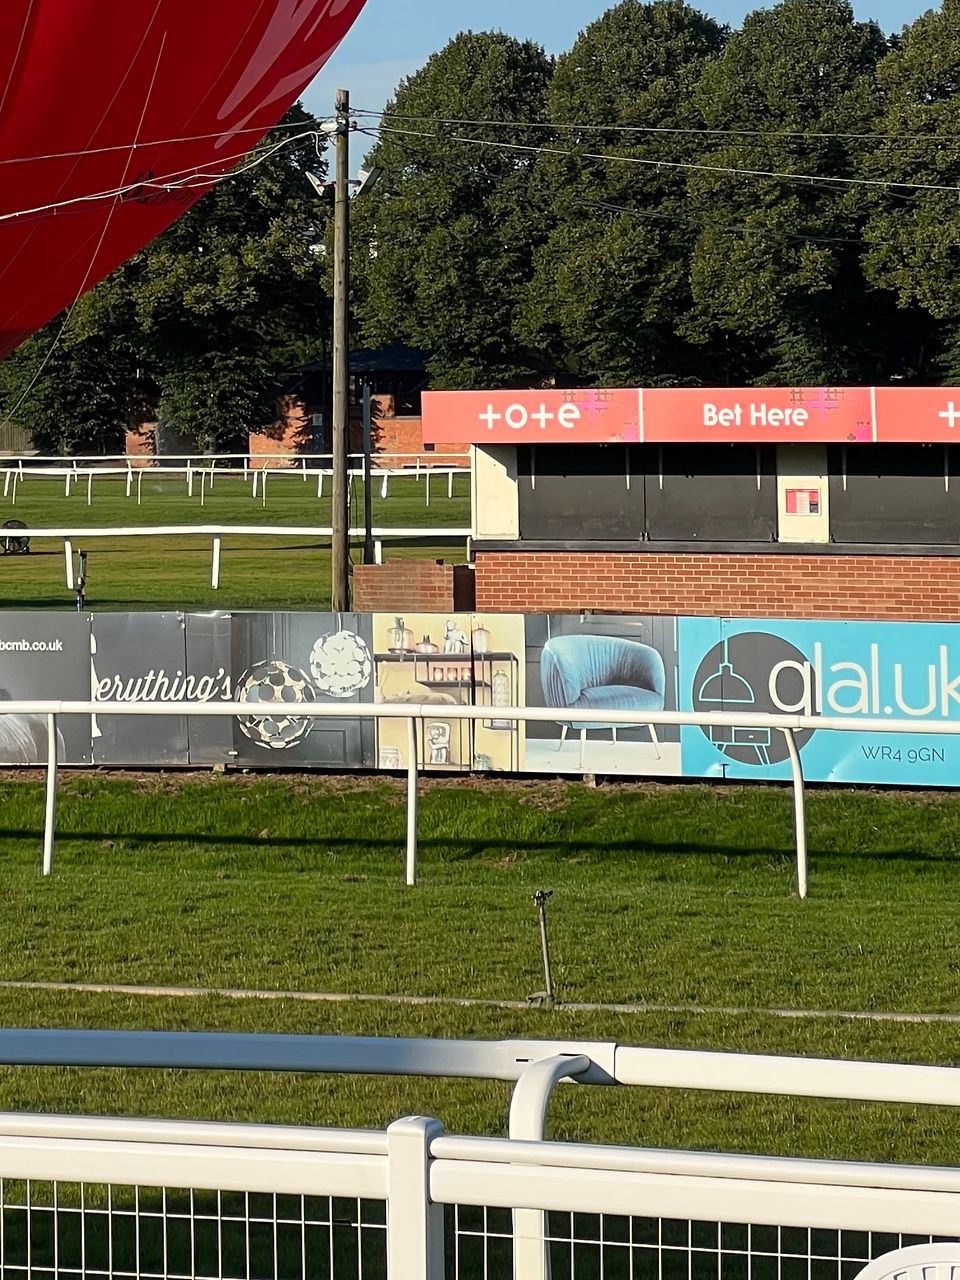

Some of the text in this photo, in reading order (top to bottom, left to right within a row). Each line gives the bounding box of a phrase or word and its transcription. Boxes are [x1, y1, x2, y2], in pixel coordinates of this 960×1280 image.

[703, 404, 808, 427] Bet Here
[861, 745, 945, 763] WR4 9GN
